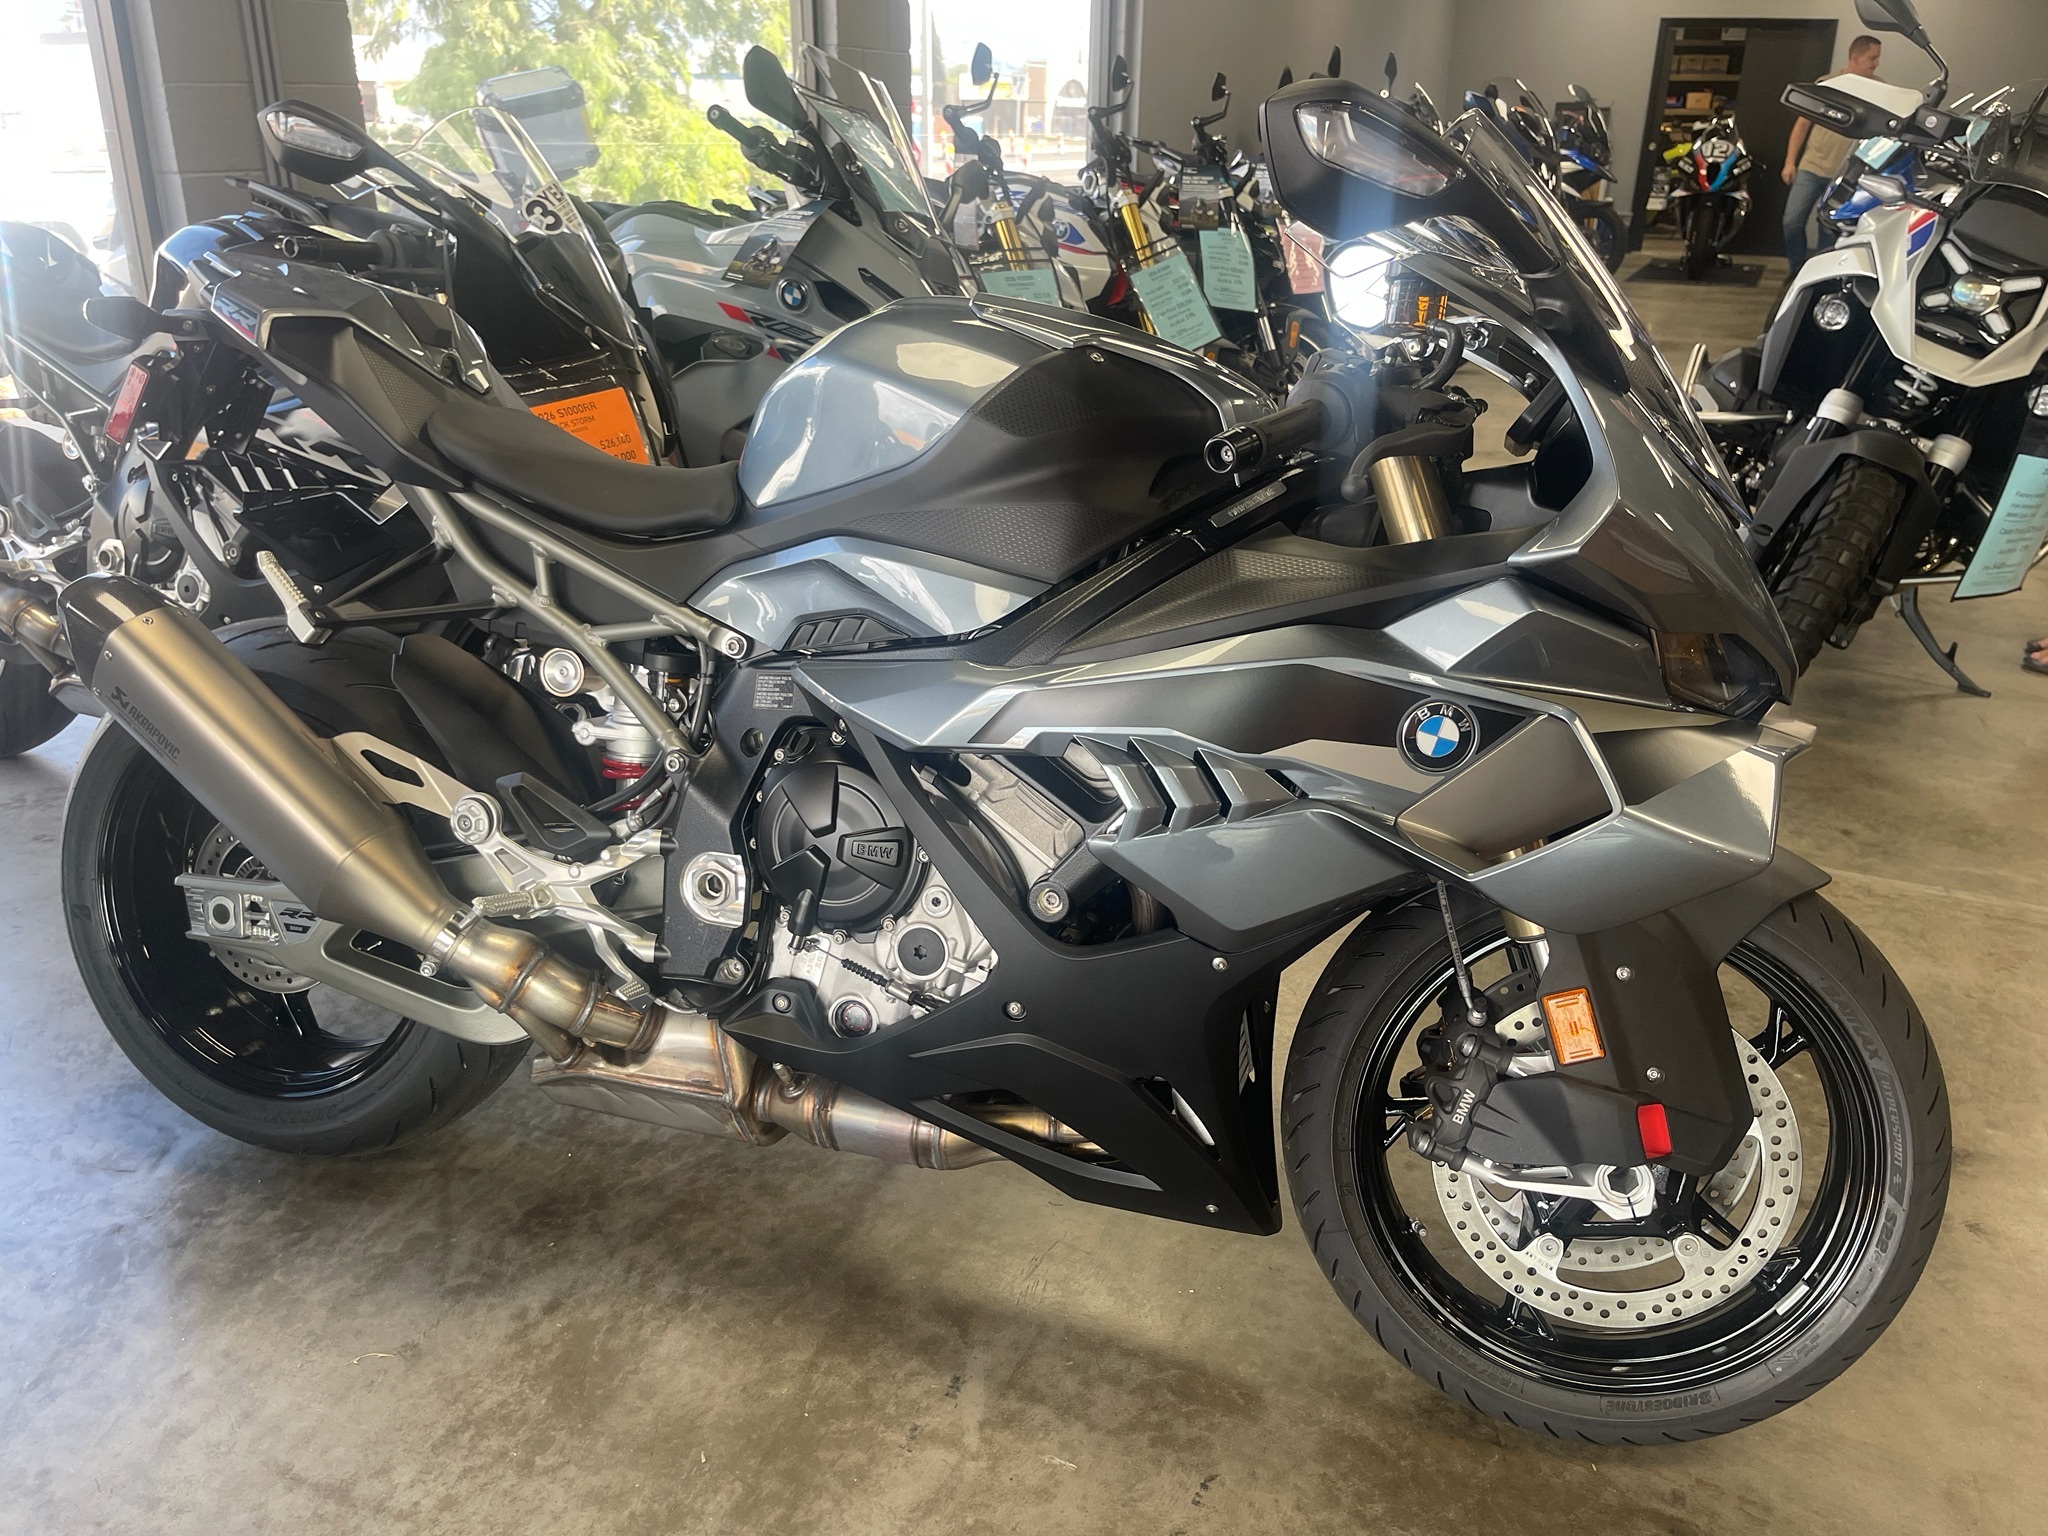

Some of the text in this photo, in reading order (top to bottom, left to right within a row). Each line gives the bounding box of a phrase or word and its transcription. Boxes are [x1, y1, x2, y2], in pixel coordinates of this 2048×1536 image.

[556, 401, 597, 419] S1000RR
[570, 415, 596, 427] STORM
[1416, 704, 1471, 733] BMW
[857, 843, 894, 859] BMW
[1452, 1088, 1476, 1125] BMW
[1880, 1079, 1905, 1168] HYPERSPORT
